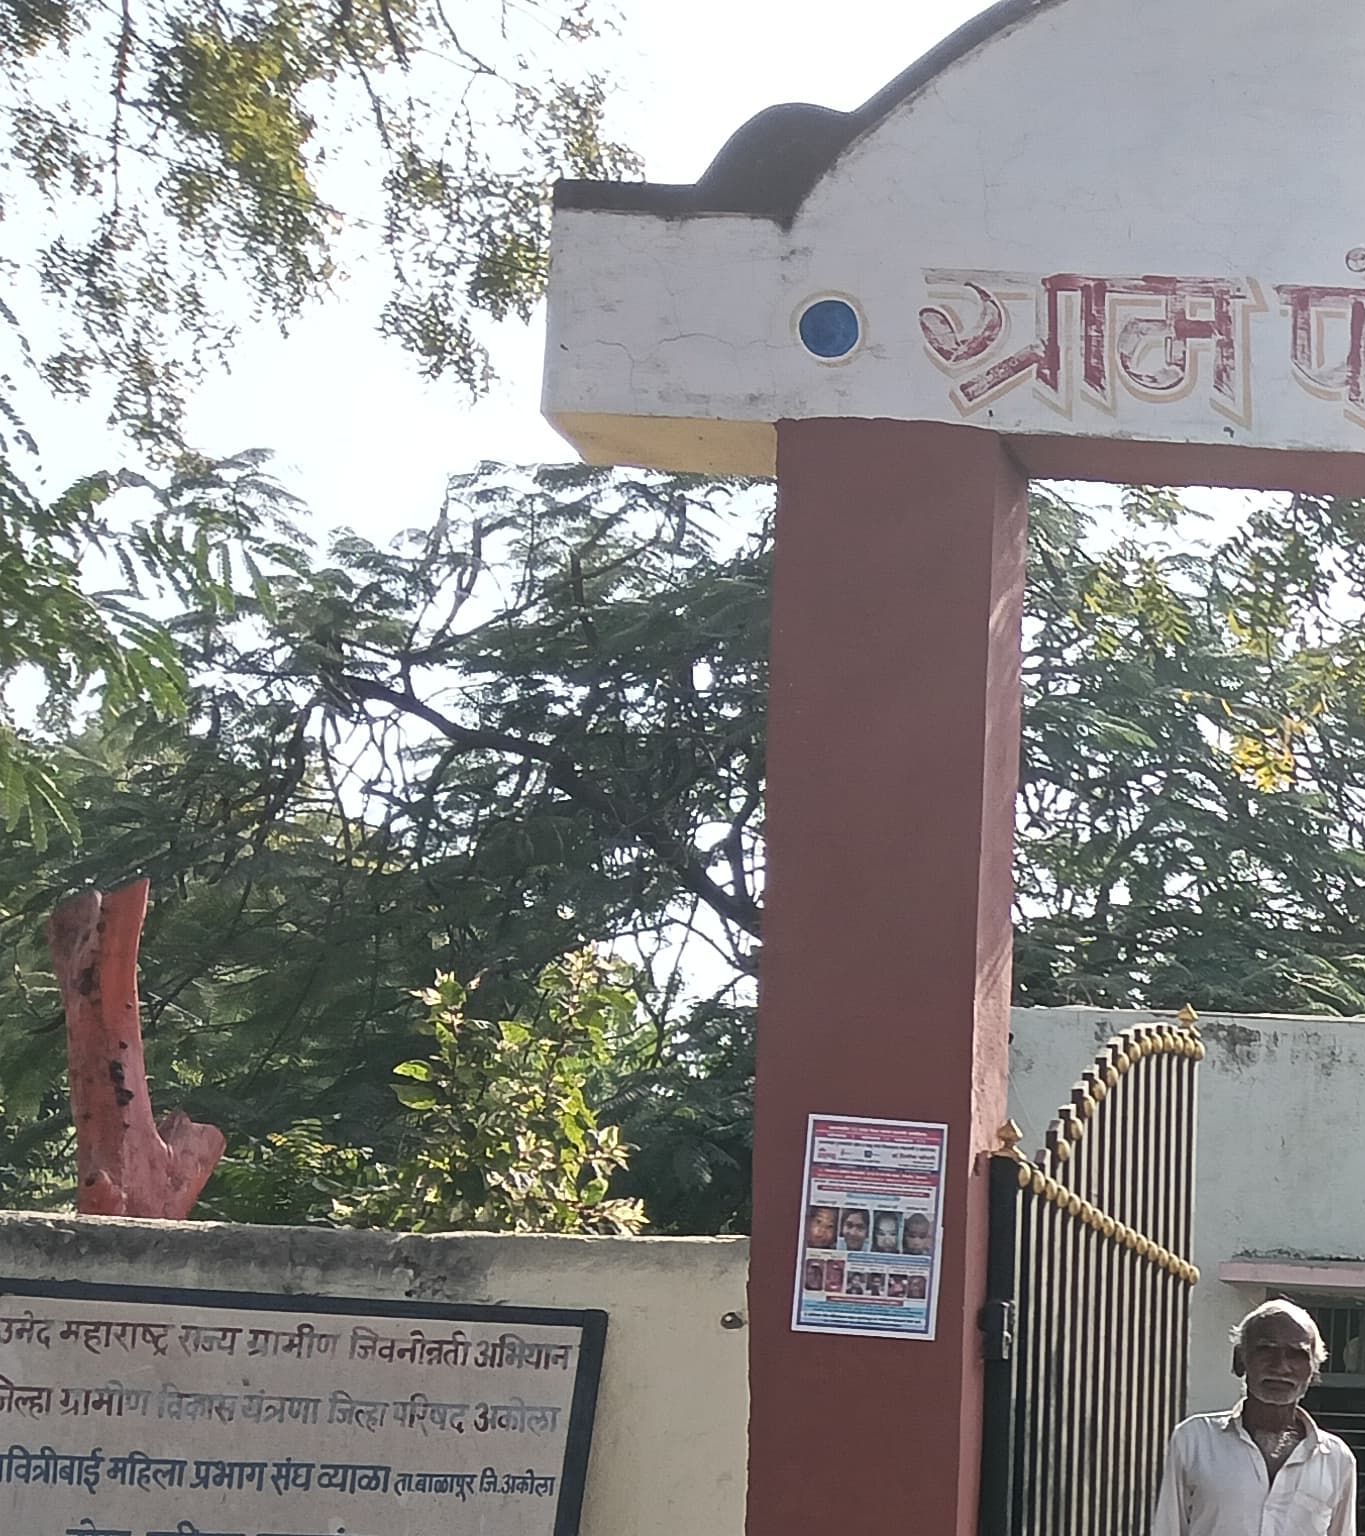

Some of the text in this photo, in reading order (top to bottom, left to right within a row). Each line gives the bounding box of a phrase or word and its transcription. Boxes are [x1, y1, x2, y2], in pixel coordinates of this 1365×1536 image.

[918, 266, 1262, 420] ग्राम
[59, 1319, 174, 1355] महाराष्ट्र
[178, 1324, 243, 1357] राज्य
[247, 1323, 341, 1359] ग्रामीण
[474, 1333, 573, 1370] अभियान
[60, 1379, 152, 1417] ग्रामीण
[328, 1390, 389, 1432] जिल्हा
[393, 1393, 470, 1435] परिषद
[474, 1396, 561, 1434] अकोला
[0, 1444, 104, 1494] ावित्रीबाई
[107, 1451, 187, 1491] महिला
[190, 1460, 267, 1491] प्रभाग
[271, 1457, 315, 1495] संघ
[317, 1463, 391, 1494] व्याळा
